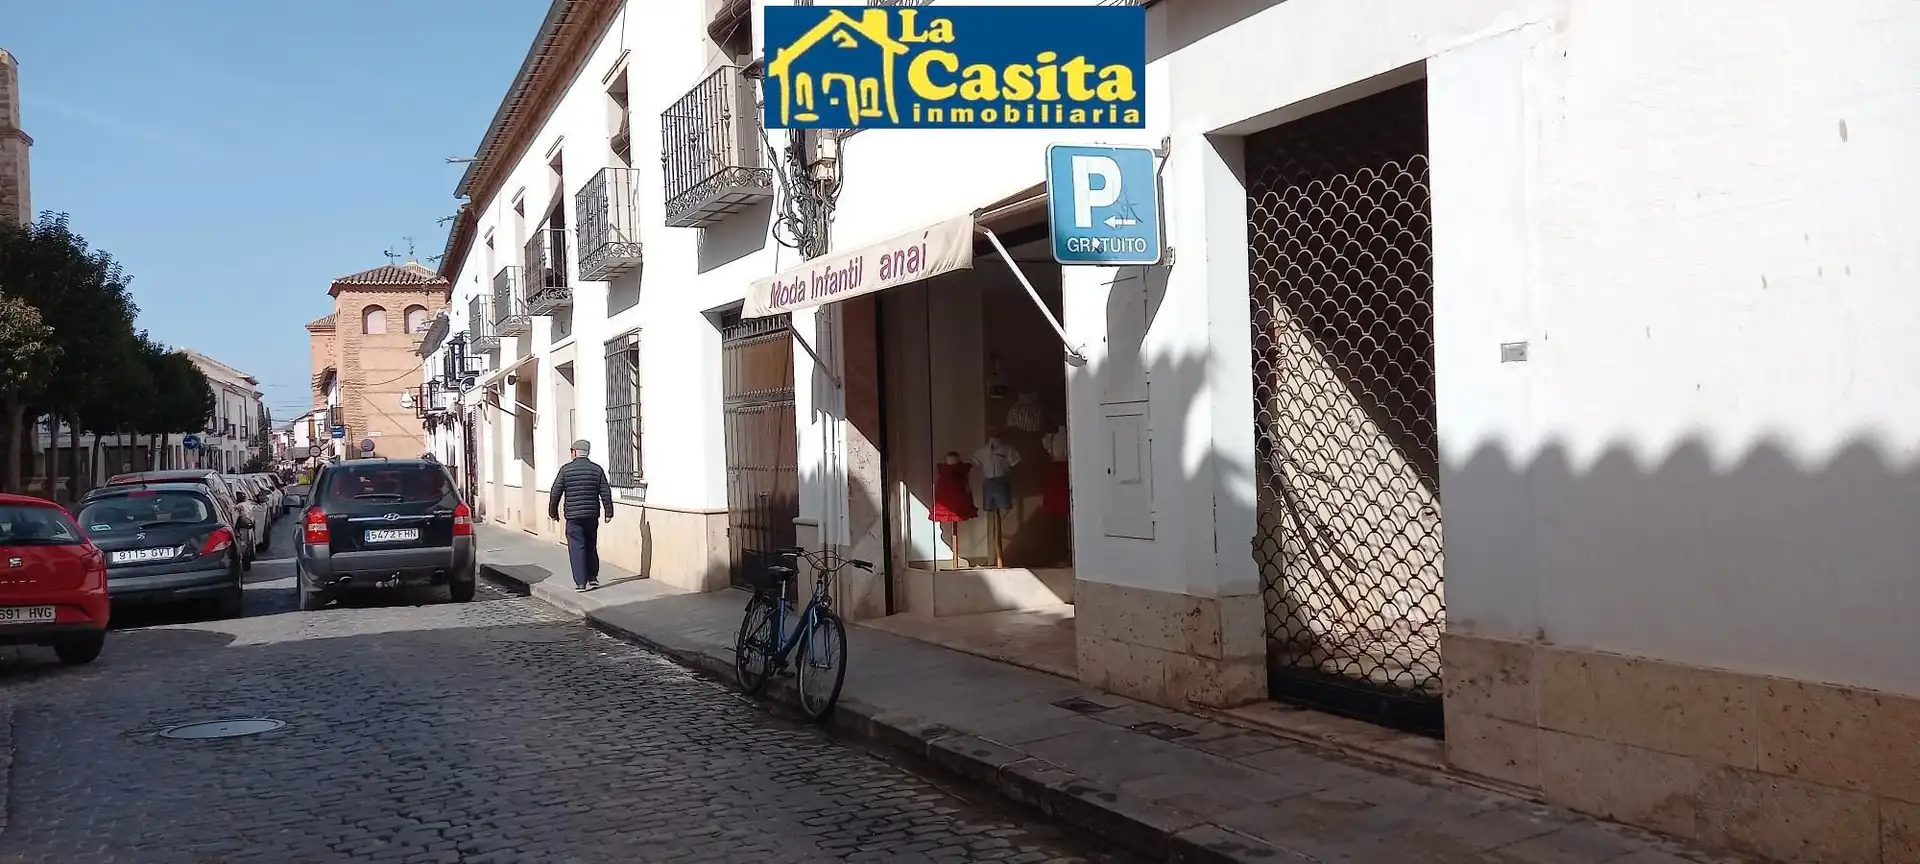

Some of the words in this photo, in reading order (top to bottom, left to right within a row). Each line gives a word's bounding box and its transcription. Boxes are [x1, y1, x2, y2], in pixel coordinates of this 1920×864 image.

[1072, 154, 1122, 229] P
[1067, 237, 1147, 252] GRATUITO
[769, 276, 806, 309] Moda
[811, 255, 863, 299] Infantil
[879, 231, 929, 281] anaí
[371, 530, 396, 540] 5472
[398, 528, 417, 539] FHN
[119, 549, 146, 560] 9115
[151, 547, 173, 557] GVT
[29, 607, 52, 618] HVG
